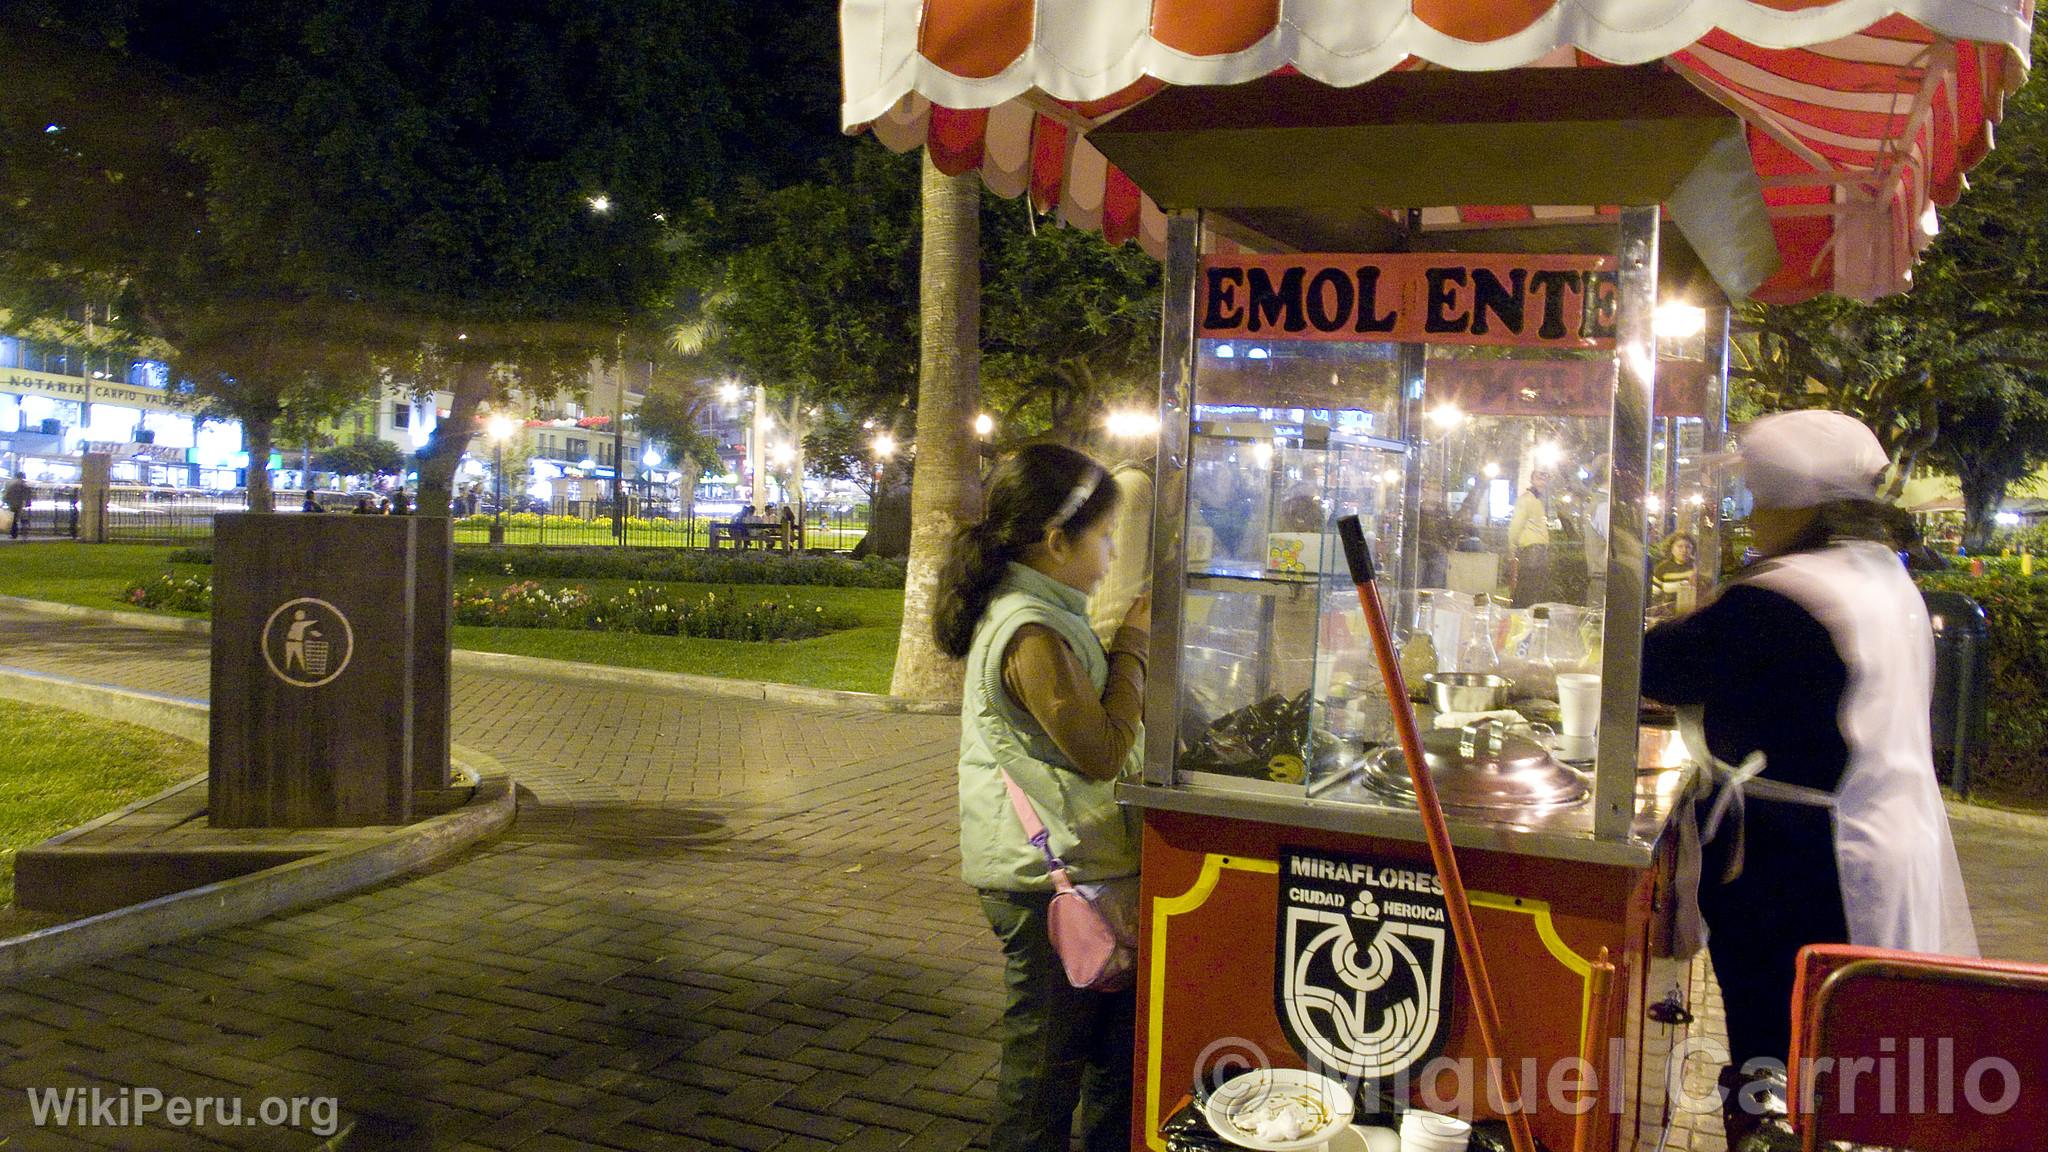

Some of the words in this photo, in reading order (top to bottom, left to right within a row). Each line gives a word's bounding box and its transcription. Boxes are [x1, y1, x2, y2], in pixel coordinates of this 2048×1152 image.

[10, 375, 84, 395] NOTARIA
[95, 386, 137, 401] CARPIO
[1290, 855, 1444, 896] MIRAFLORES
[1289, 887, 1345, 907] CIUDAD
[1383, 901, 1445, 922] HEROICA
